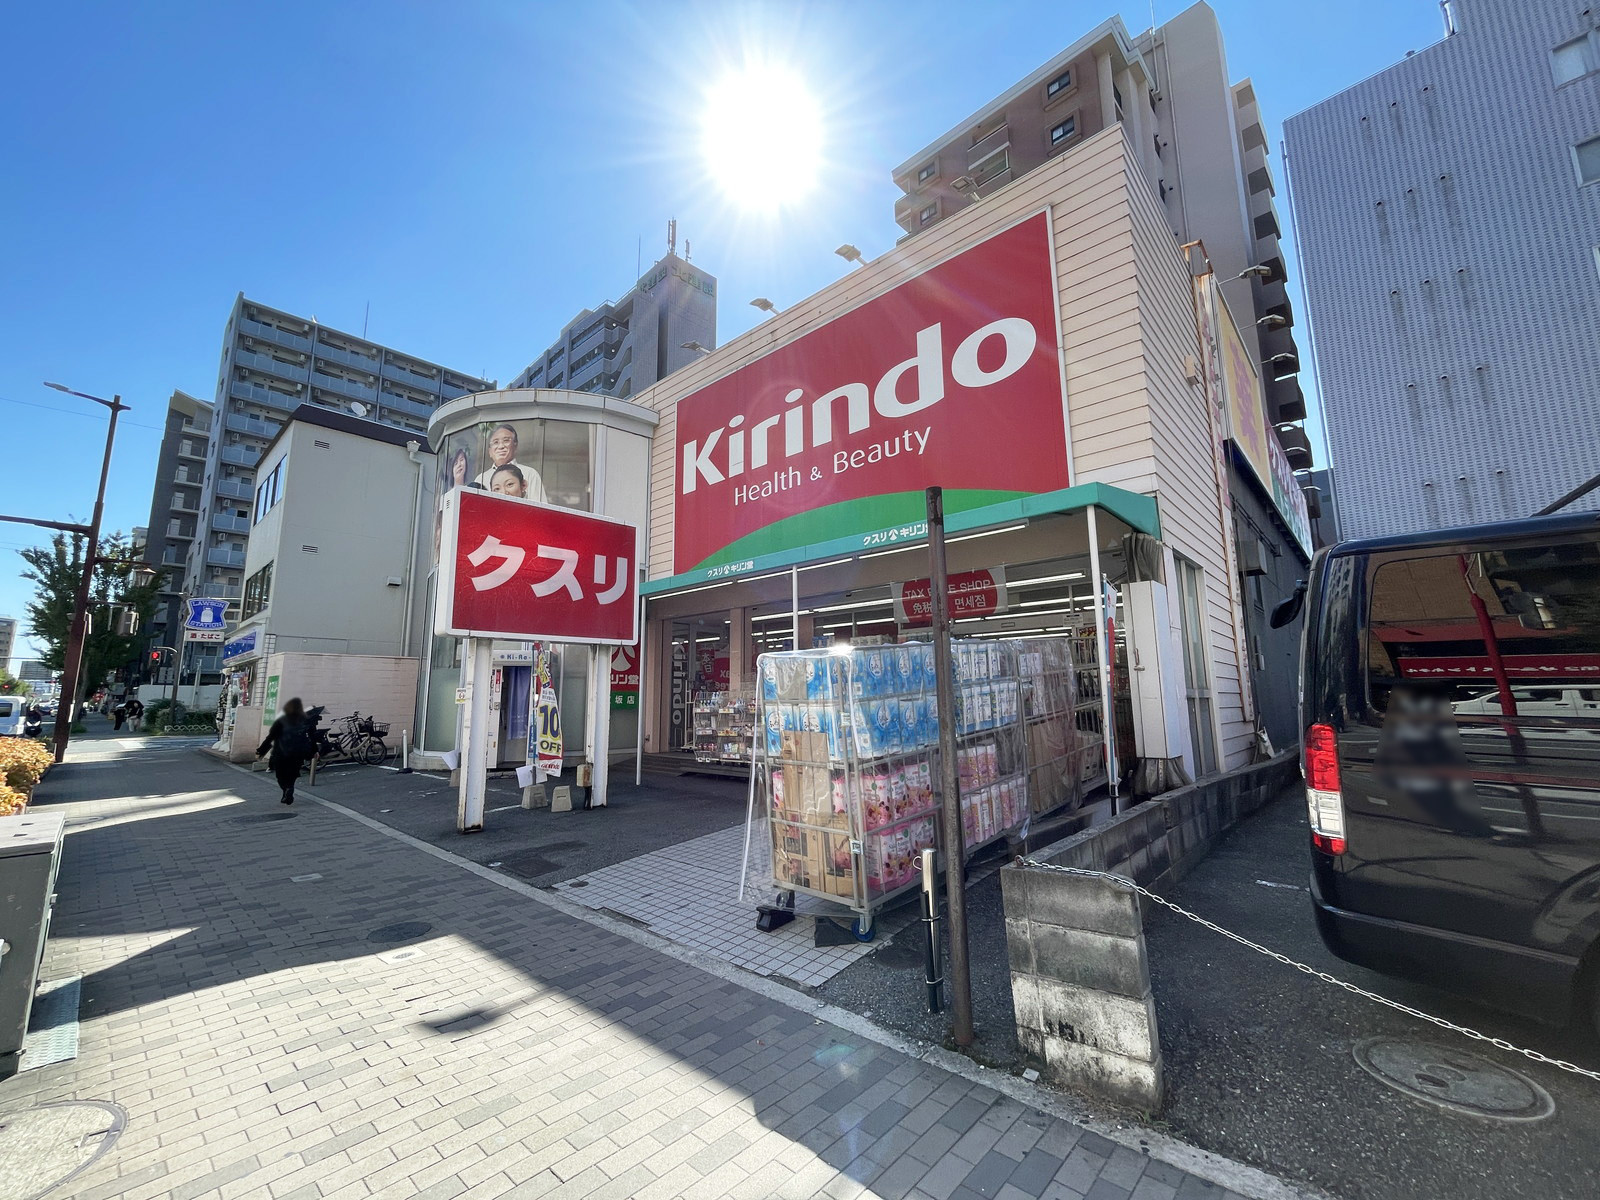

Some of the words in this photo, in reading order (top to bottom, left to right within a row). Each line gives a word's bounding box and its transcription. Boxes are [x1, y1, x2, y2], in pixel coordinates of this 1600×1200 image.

[682, 317, 1037, 495] Kirindo
[734, 465, 801, 507] Health
[809, 465, 823, 482] &
[833, 426, 932, 475] Beauty
[862, 531, 888, 547] クスリ
[467, 534, 628, 605] クスリ
[707, 567, 723, 578] クスリ
[730, 560, 754, 572] キリン堂
[905, 588, 925, 600] TAX
[960, 579, 991, 592] SHOP
[192, 600, 225, 608] LAWSON
[954, 594, 986, 610] 면세점
[611, 674, 639, 685] リン堂
[672, 637, 686, 725] Kirindo
[611, 695, 635, 704] 坂店
[539, 704, 560, 738] 10
[540, 740, 562, 752] OFF
